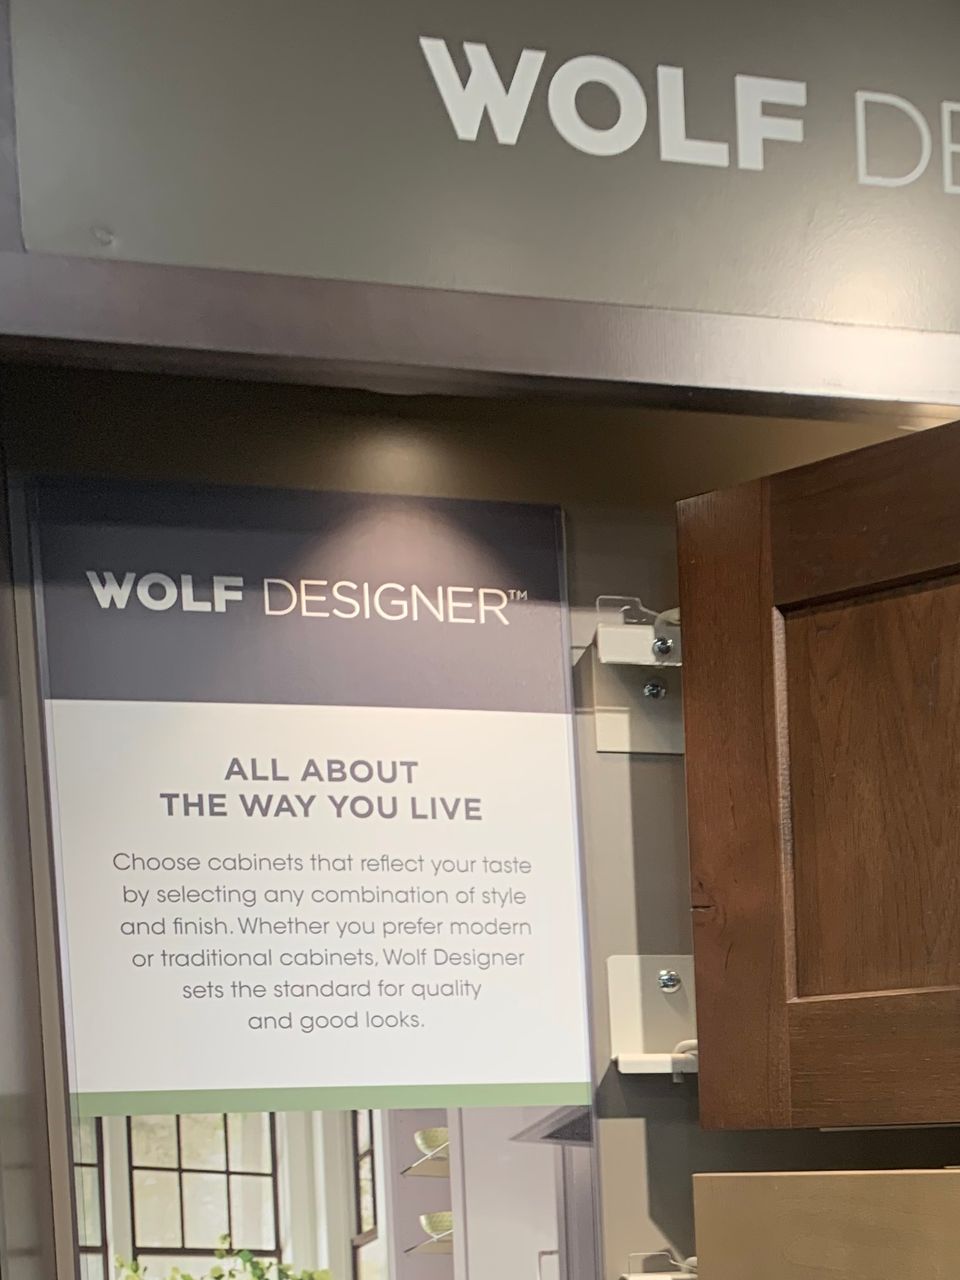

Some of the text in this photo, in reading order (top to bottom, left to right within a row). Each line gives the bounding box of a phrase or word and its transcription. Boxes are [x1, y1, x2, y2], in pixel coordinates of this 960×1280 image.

[418, 34, 808, 172] WOLF
[85, 570, 529, 624] WOLF DESIGNER™
[223, 757, 419, 784] ALL ABOUT
[159, 792, 483, 821] THE WAY YOU LIVE
[112, 852, 532, 877] Choose cabinets that reflect your taste
[122, 884, 527, 909] by selecting any combination of style
[120, 916, 532, 939] and finish. Whether you prefer modern
[131, 947, 526, 971] or traditional cabinets, Wolf Designer
[182, 978, 482, 1001] sets the standard for quality
[247, 1010, 425, 1034] and good looks.
